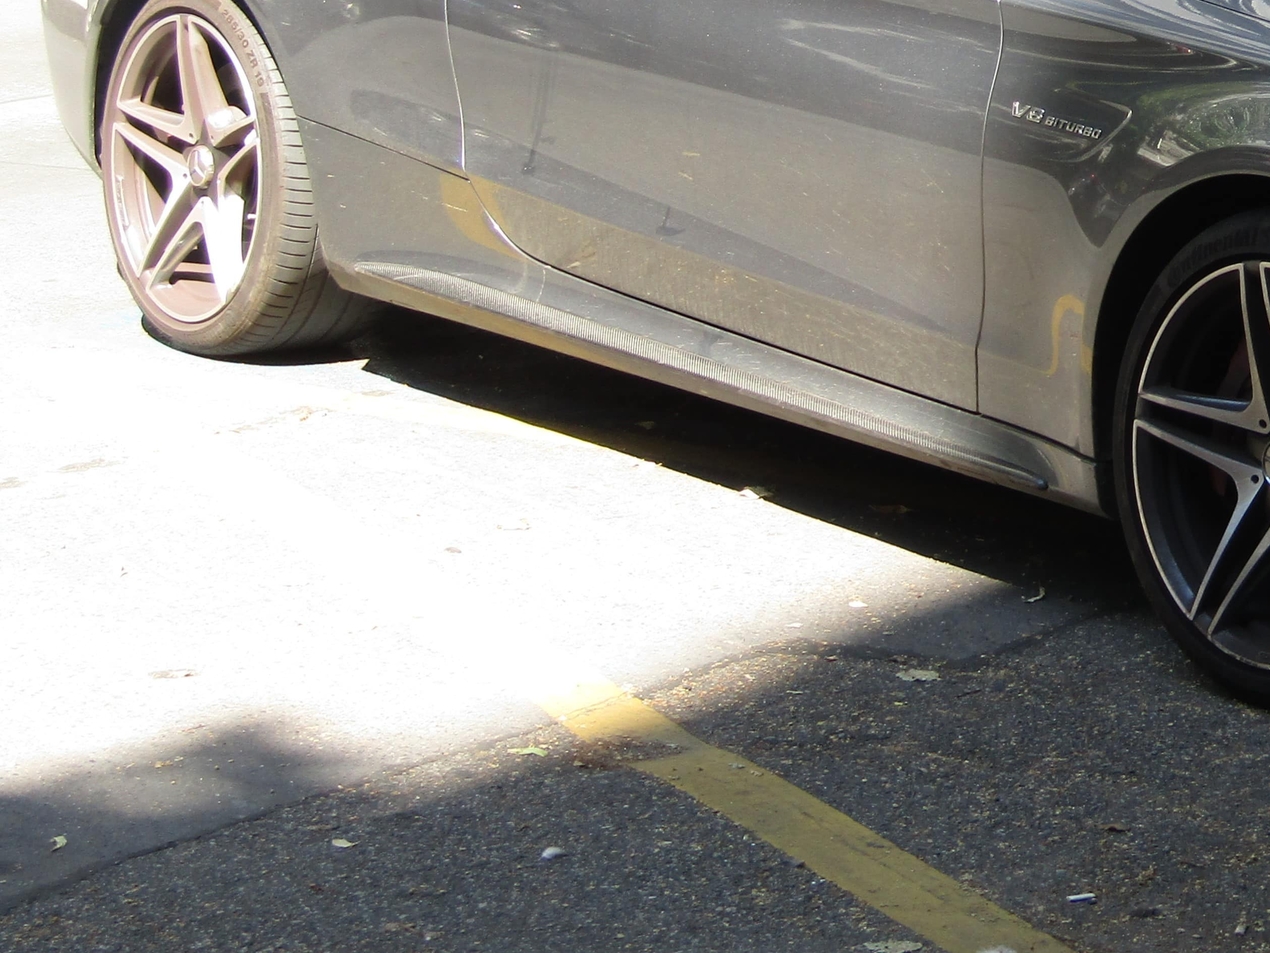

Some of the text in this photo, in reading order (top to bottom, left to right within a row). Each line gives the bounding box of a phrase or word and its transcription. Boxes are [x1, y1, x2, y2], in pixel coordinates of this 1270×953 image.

[246, 50, 259, 69] ZR
[1011, 101, 1102, 139] V8 BITURBO
